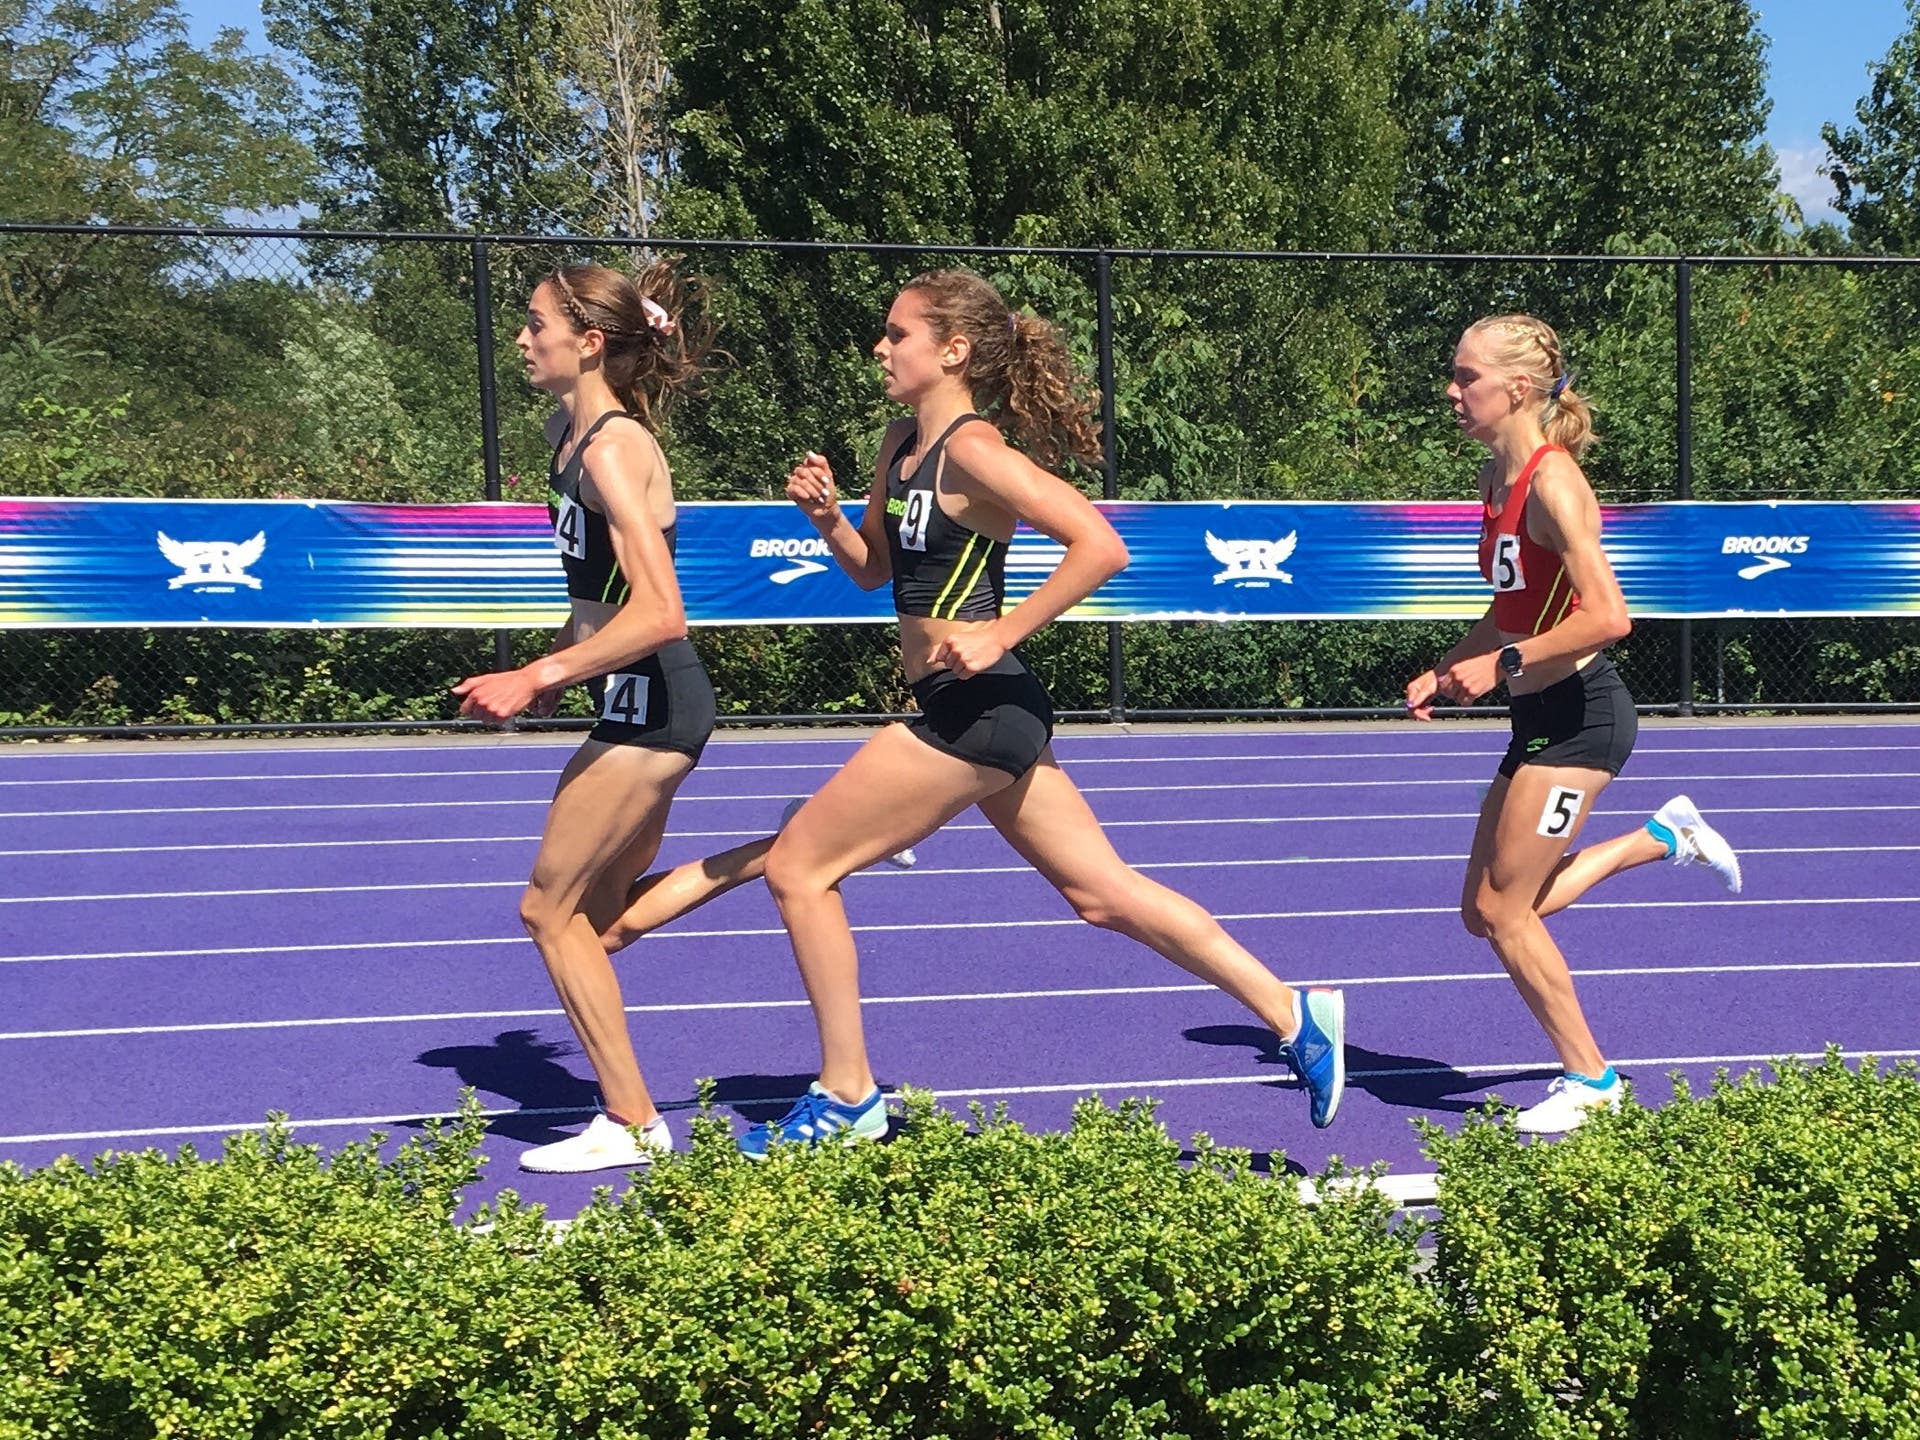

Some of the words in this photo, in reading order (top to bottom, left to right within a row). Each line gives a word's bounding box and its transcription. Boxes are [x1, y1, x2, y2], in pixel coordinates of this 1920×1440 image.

[559, 505, 579, 553] 4
[887, 497, 908, 517] BRO
[907, 493, 922, 547] 9
[750, 538, 834, 558] BROOK
[1499, 540, 1516, 589] 5
[1722, 536, 1810, 554] BROOKS
[610, 677, 639, 723] 4
[1547, 791, 1578, 835] 5
